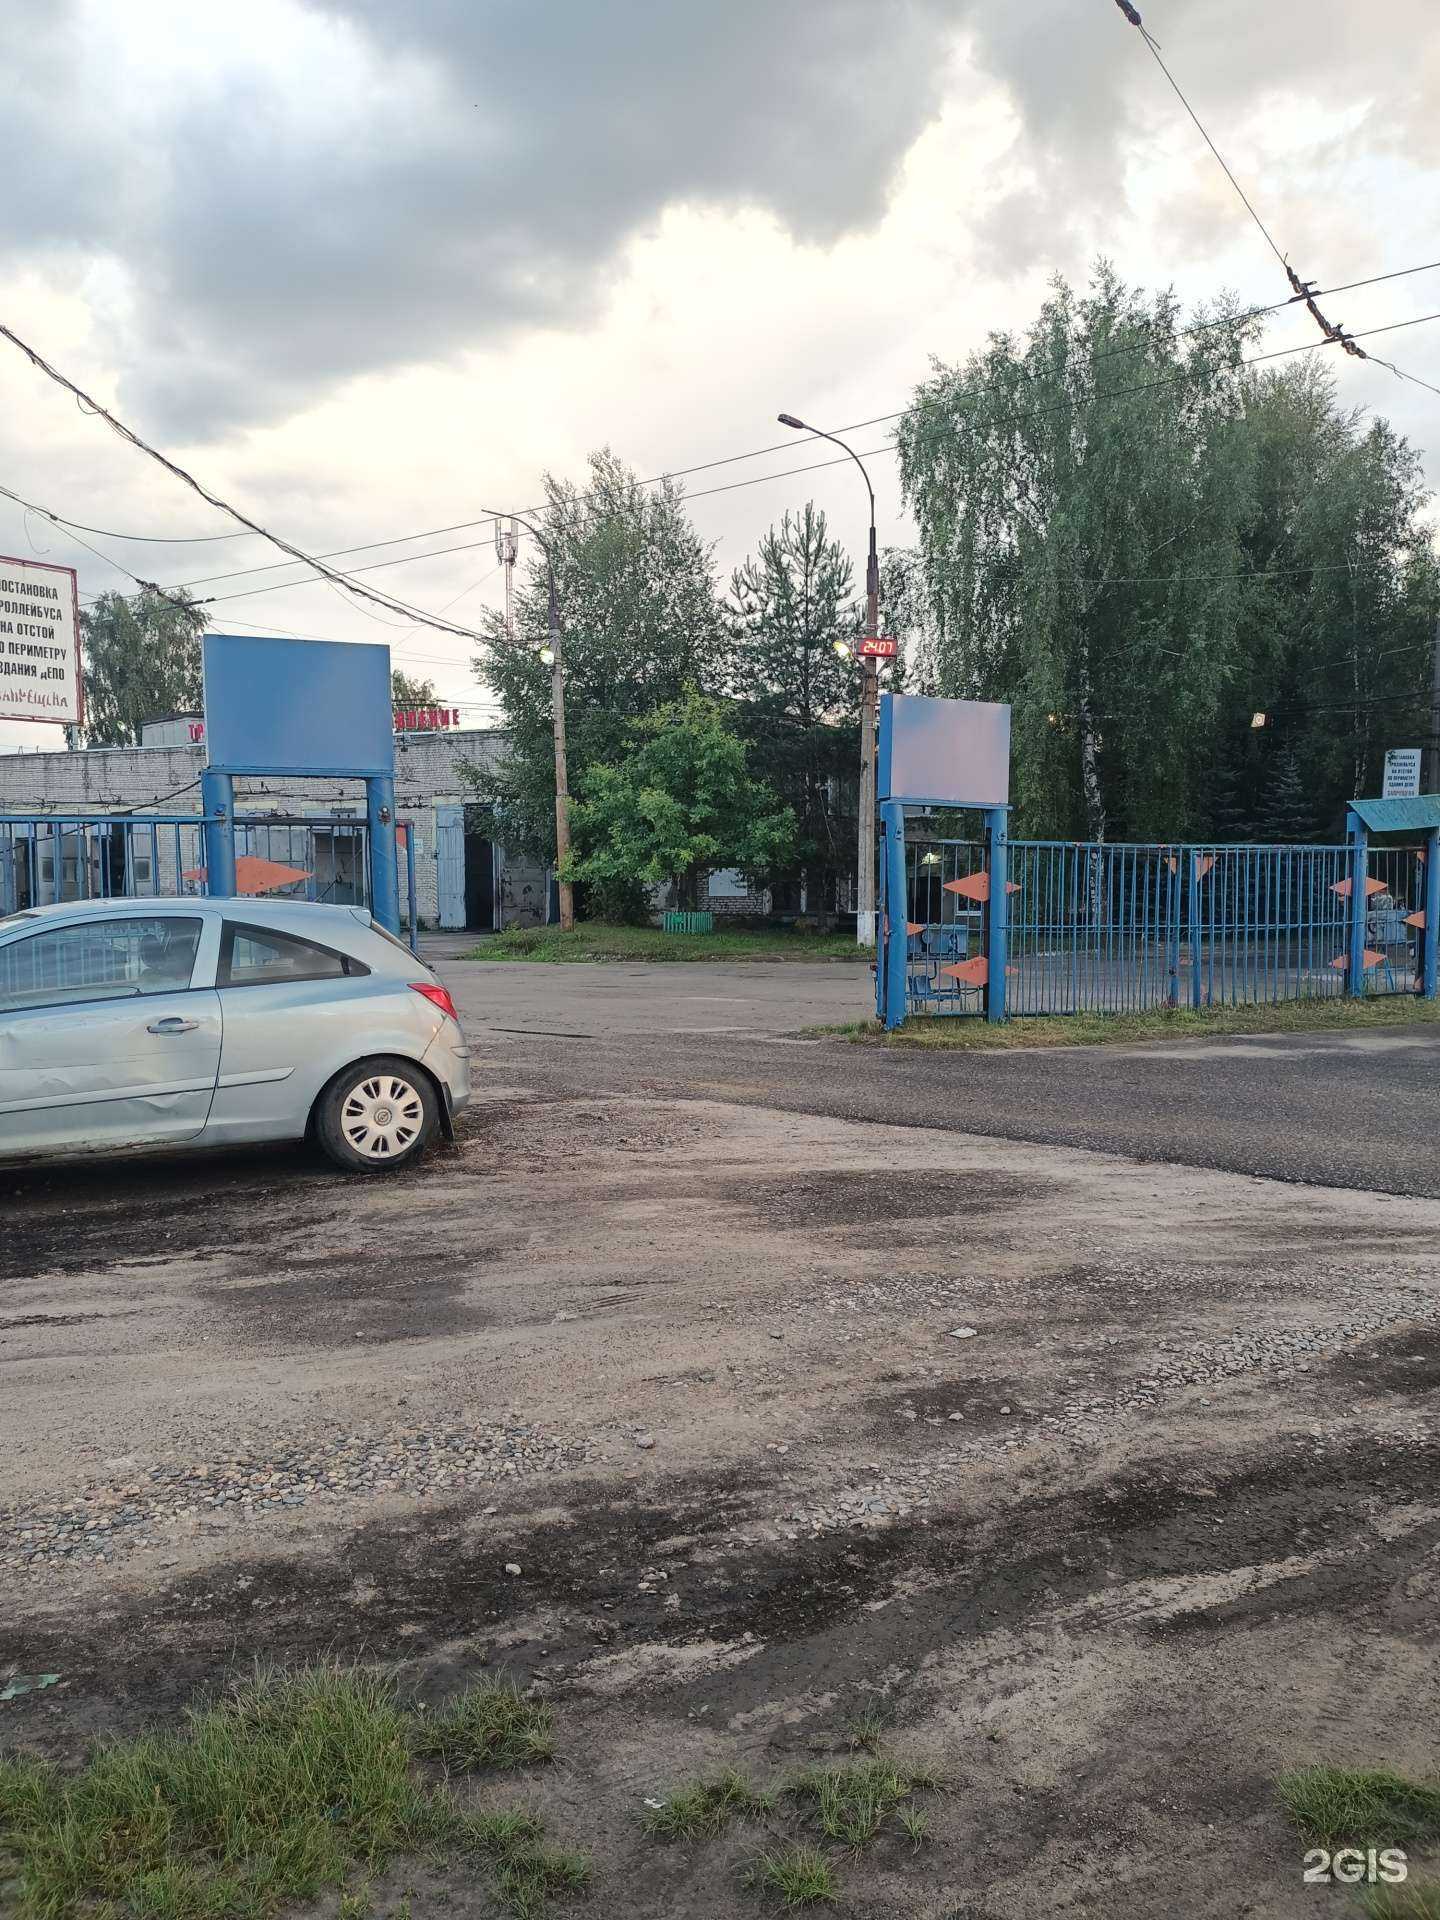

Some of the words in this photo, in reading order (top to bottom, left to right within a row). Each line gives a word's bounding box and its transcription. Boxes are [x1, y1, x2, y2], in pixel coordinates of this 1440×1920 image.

[0, 579, 58, 600] ОСТАНОВКА
[17, 623, 54, 640] ОТСТОЙ
[8, 642, 67, 661] ПЕРИМЕТРУ
[0, 688, 68, 707] АПРЕЩЕНА
